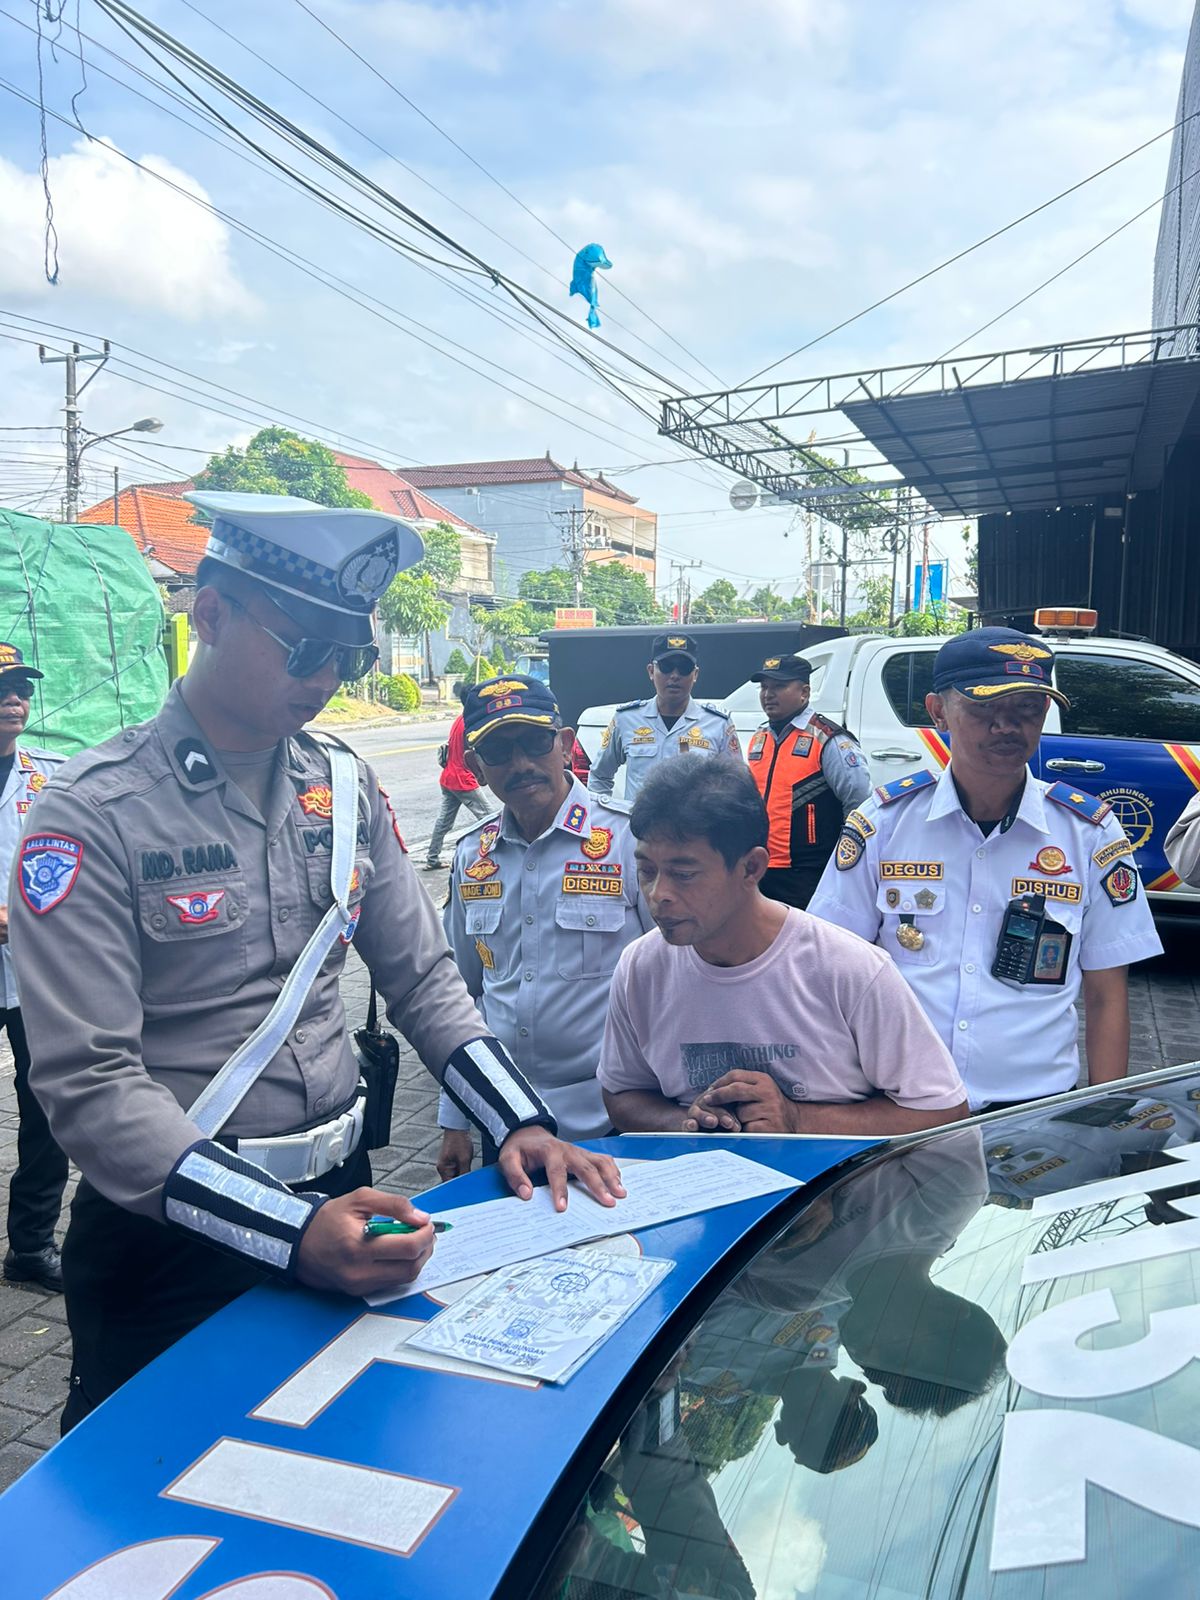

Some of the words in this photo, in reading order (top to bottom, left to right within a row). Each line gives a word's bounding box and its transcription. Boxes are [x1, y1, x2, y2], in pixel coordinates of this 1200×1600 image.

[46, 839, 76, 852] LINTAS
[141, 851, 182, 882] MD.
[182, 843, 239, 875] RAMA
[883, 864, 939, 876] DEGUS
[566, 878, 620, 893] DISHUB
[1016, 880, 1078, 898] DISHUB
[731, 1043, 796, 1066] NOTHING
